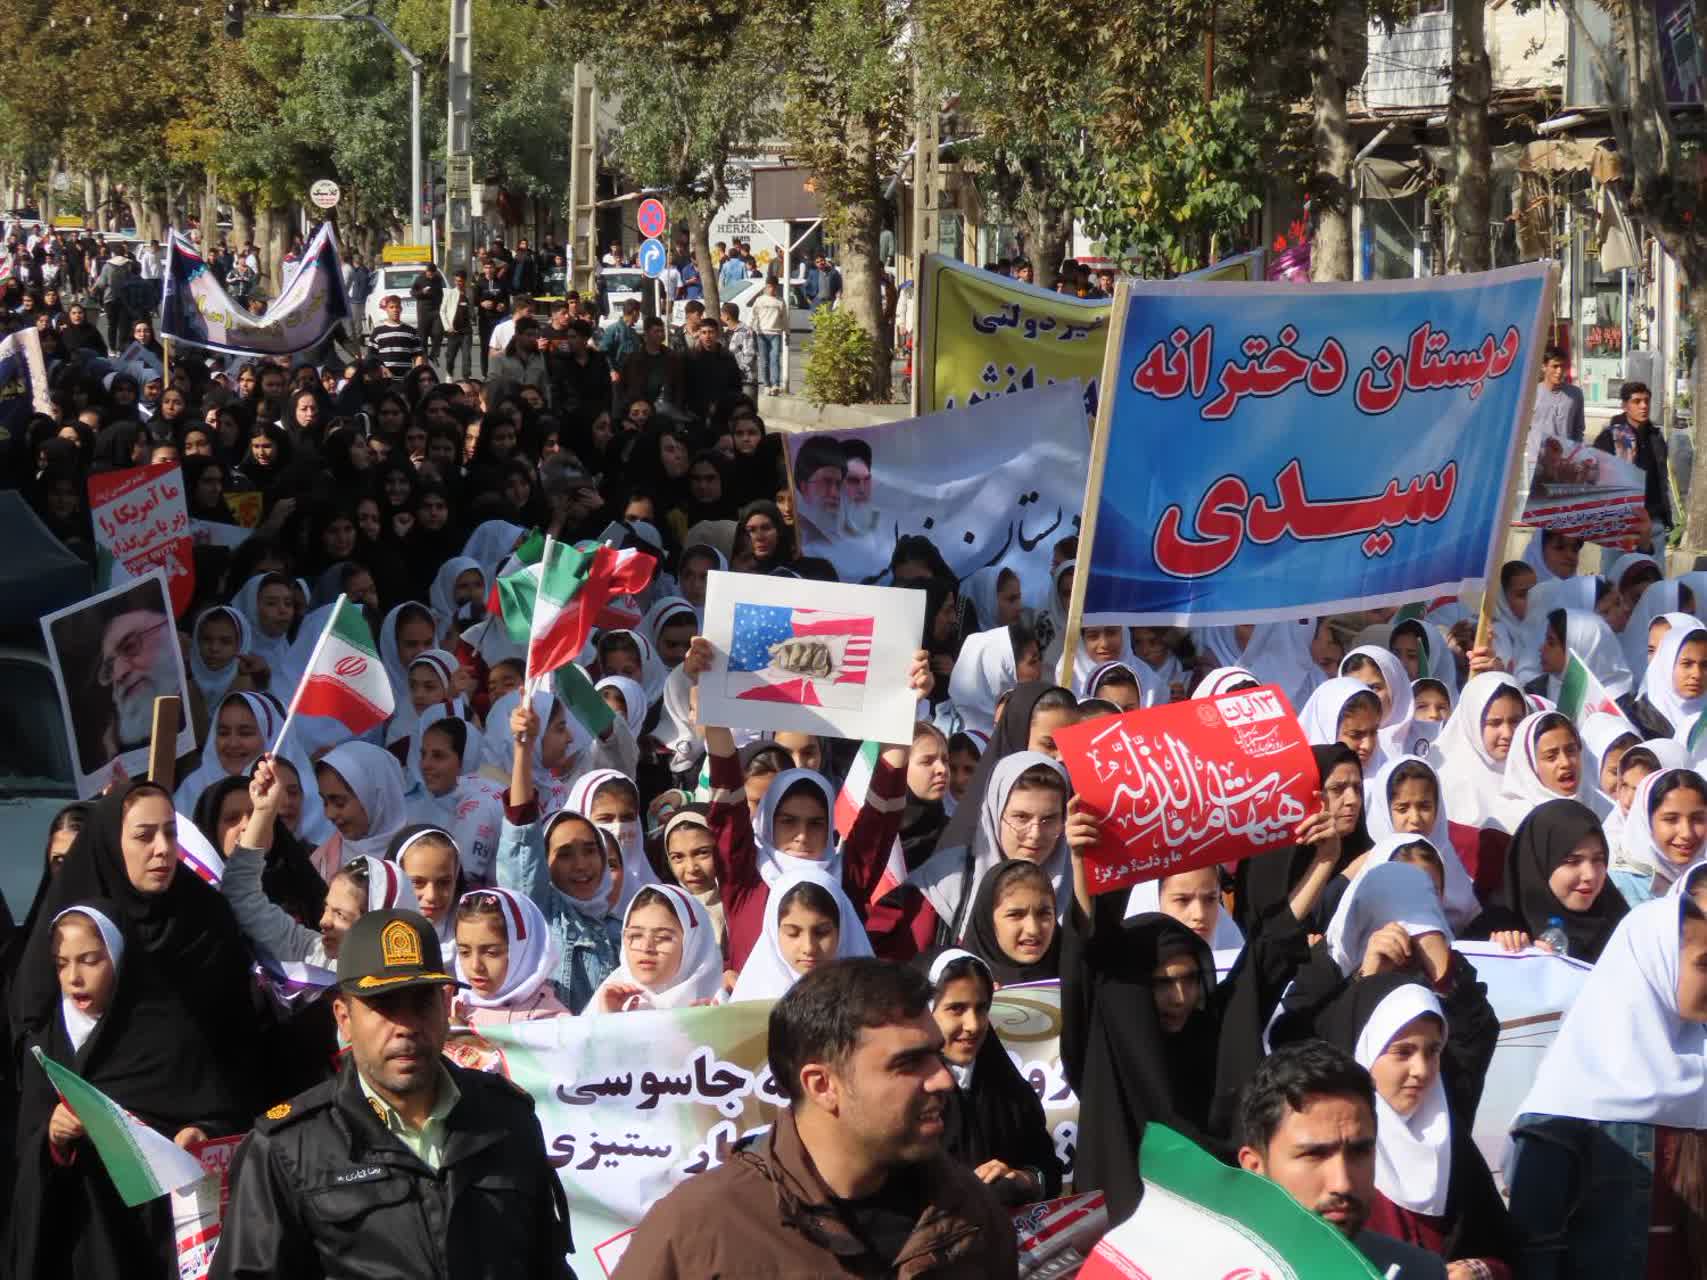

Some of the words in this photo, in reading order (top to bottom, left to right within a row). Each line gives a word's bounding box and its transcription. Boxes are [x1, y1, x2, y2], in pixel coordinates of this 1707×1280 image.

[973, 303, 1057, 339] دولتی
[1132, 323, 1348, 421] دخترانه
[1354, 321, 1520, 416] دبستان
[160, 483, 179, 500] ما
[98, 515, 116, 538] را
[1152, 456, 1457, 579] سیدی
[1222, 695, 1258, 721] آبان
[1170, 850, 1182, 863] ما
[556, 1054, 746, 1112] جاسوسی
[546, 1131, 673, 1171] ستیزی
